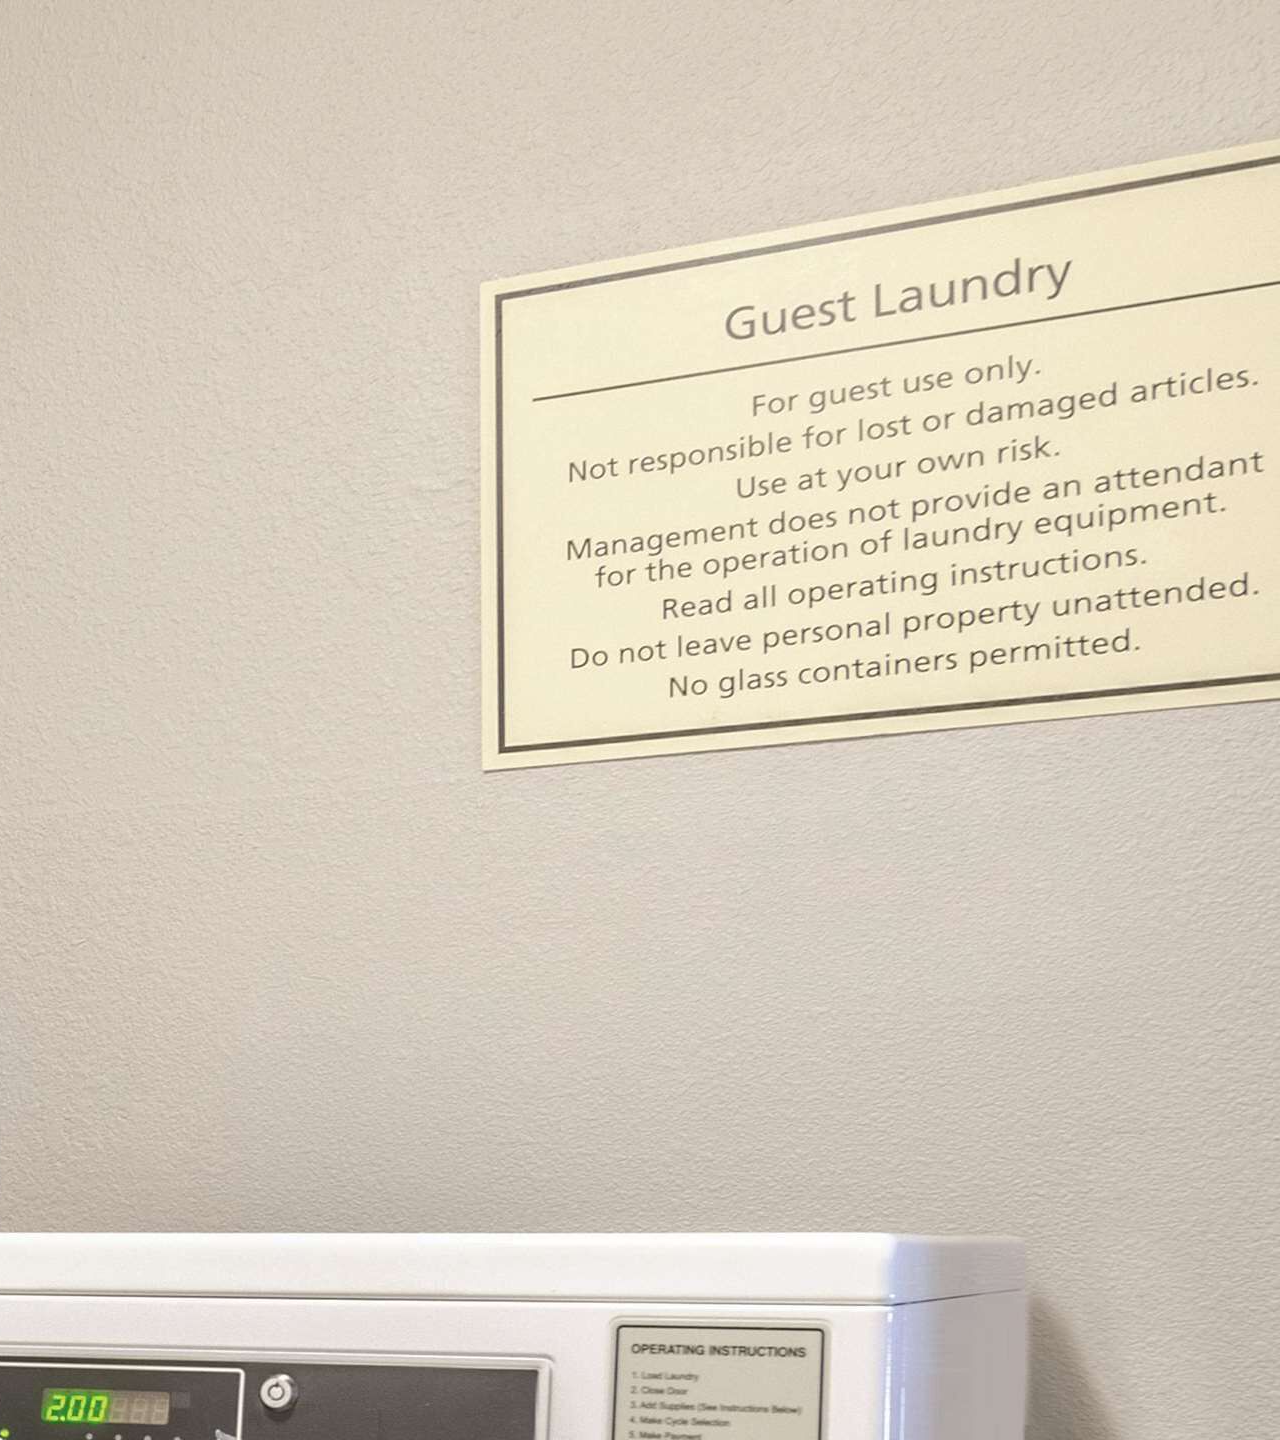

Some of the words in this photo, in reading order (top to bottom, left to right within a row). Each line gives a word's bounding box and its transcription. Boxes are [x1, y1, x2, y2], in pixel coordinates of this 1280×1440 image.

[725, 291, 857, 341] Guest
[874, 257, 1073, 318] Laundry
[752, 393, 799, 417] For
[808, 377, 892, 415] guest
[903, 371, 954, 394] use
[964, 354, 1041, 385] only.
[568, 457, 619, 483] Not
[628, 431, 792, 475] responsible
[801, 425, 847, 449] for
[858, 415, 912, 442] lost
[922, 411, 956, 433] or
[965, 381, 1118, 426] damaged
[1130, 367, 1259, 404] articles.
[736, 475, 788, 499] Use
[797, 467, 828, 491] at
[836, 459, 907, 492] your
[917, 449, 985, 475] own
[997, 434, 1060, 464] risk.
[566, 517, 759, 561] Management
[768, 510, 838, 535] does
[848, 498, 901, 525] not
[911, 480, 1031, 523] provide
[1042, 479, 1082, 500] an
[1094, 451, 1265, 494] attendant
[594, 564, 637, 589] for
[644, 558, 693, 583] the
[702, 540, 849, 579] operation
[860, 528, 893, 556] of
[904, 516, 1024, 551] laundry
[1034, 492, 1226, 538] equipment.
[662, 589, 732, 620] Read
[743, 584, 776, 611] all
[787, 570, 938, 609] operating
[950, 548, 1147, 587] instructions.
[570, 647, 609, 670] Do
[619, 639, 668, 664] not
[677, 634, 752, 658] leave
[763, 611, 890, 655] personal
[903, 600, 1041, 640] property
[1052, 571, 1260, 617] unattended.
[669, 675, 709, 699] No
[718, 667, 788, 699] glass
[797, 652, 958, 685] containers
[969, 627, 1141, 674] permitted.
[632, 1343, 705, 1356] OPERATING
[709, 1345, 807, 1358] INSTRUCTIONS
[46, 1395, 108, 1423] 2.00
